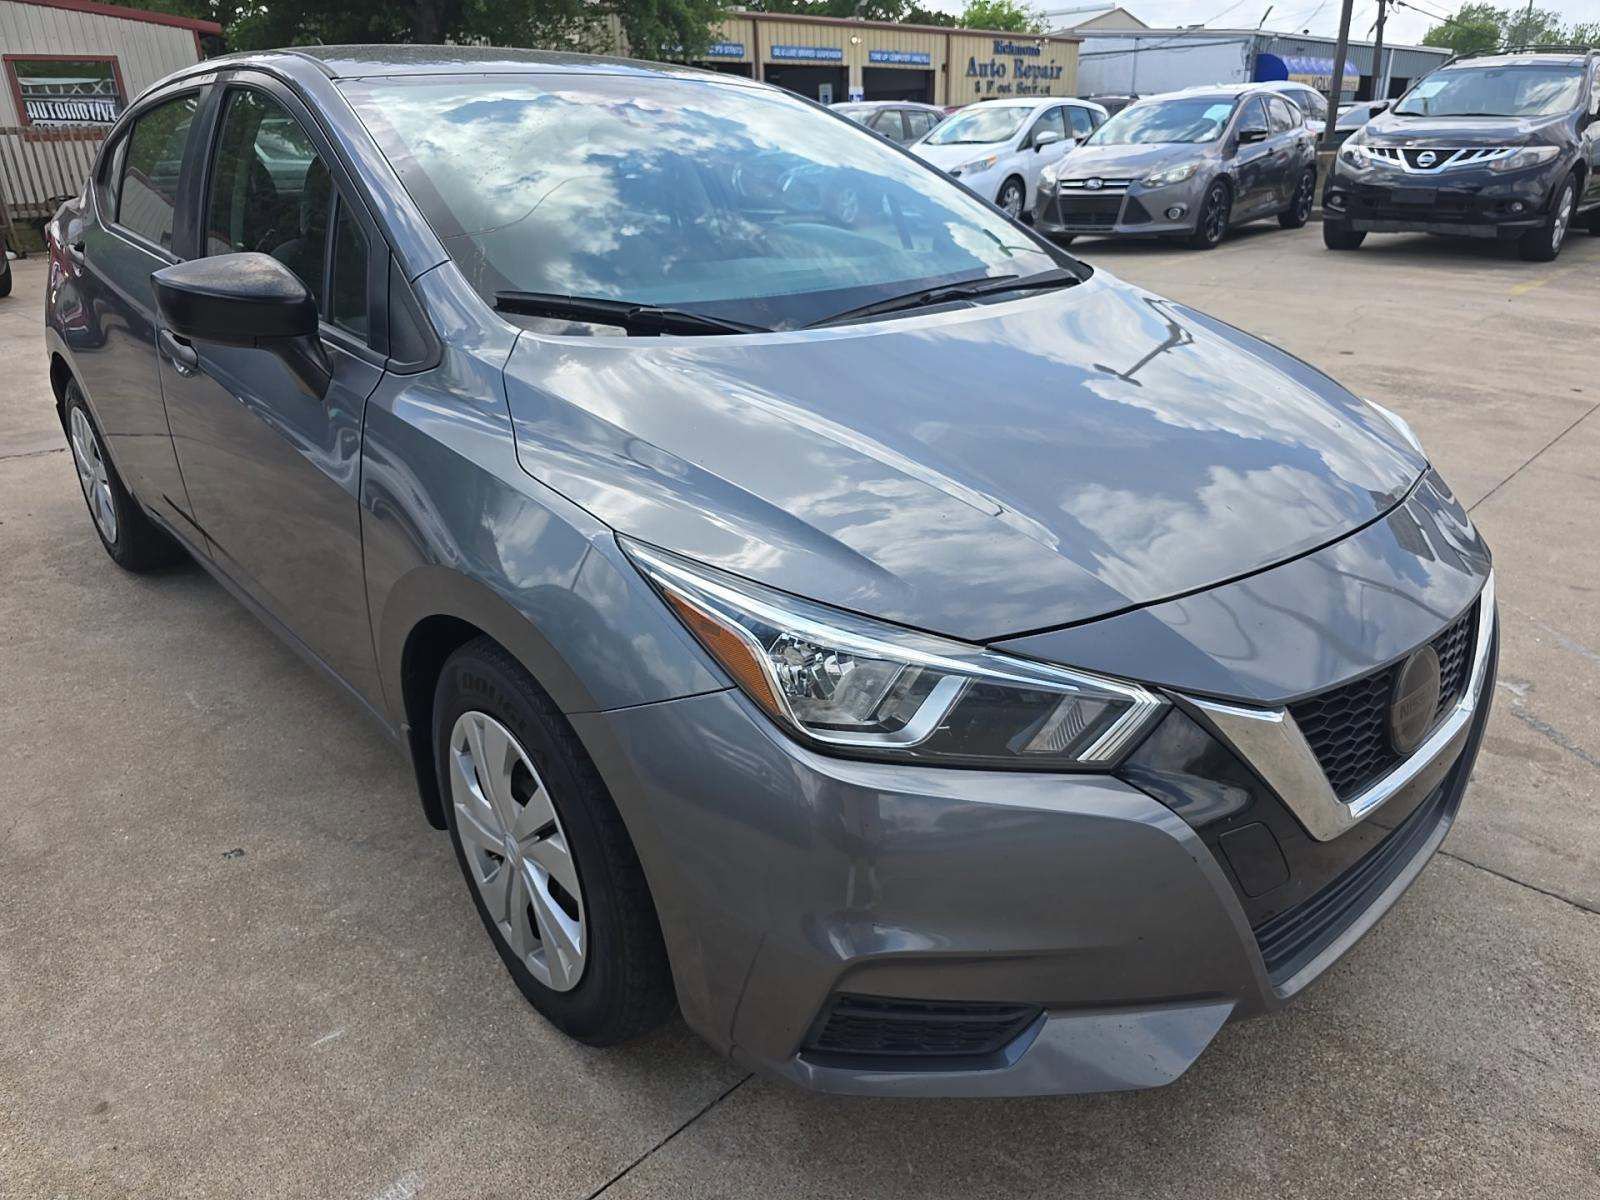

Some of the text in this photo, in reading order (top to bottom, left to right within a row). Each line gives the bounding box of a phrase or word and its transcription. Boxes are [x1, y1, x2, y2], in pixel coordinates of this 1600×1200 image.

[993, 40, 1040, 56] Richmond
[966, 56, 1062, 80] Auto Repair
[26, 101, 118, 121] AUTOMOTIVE
